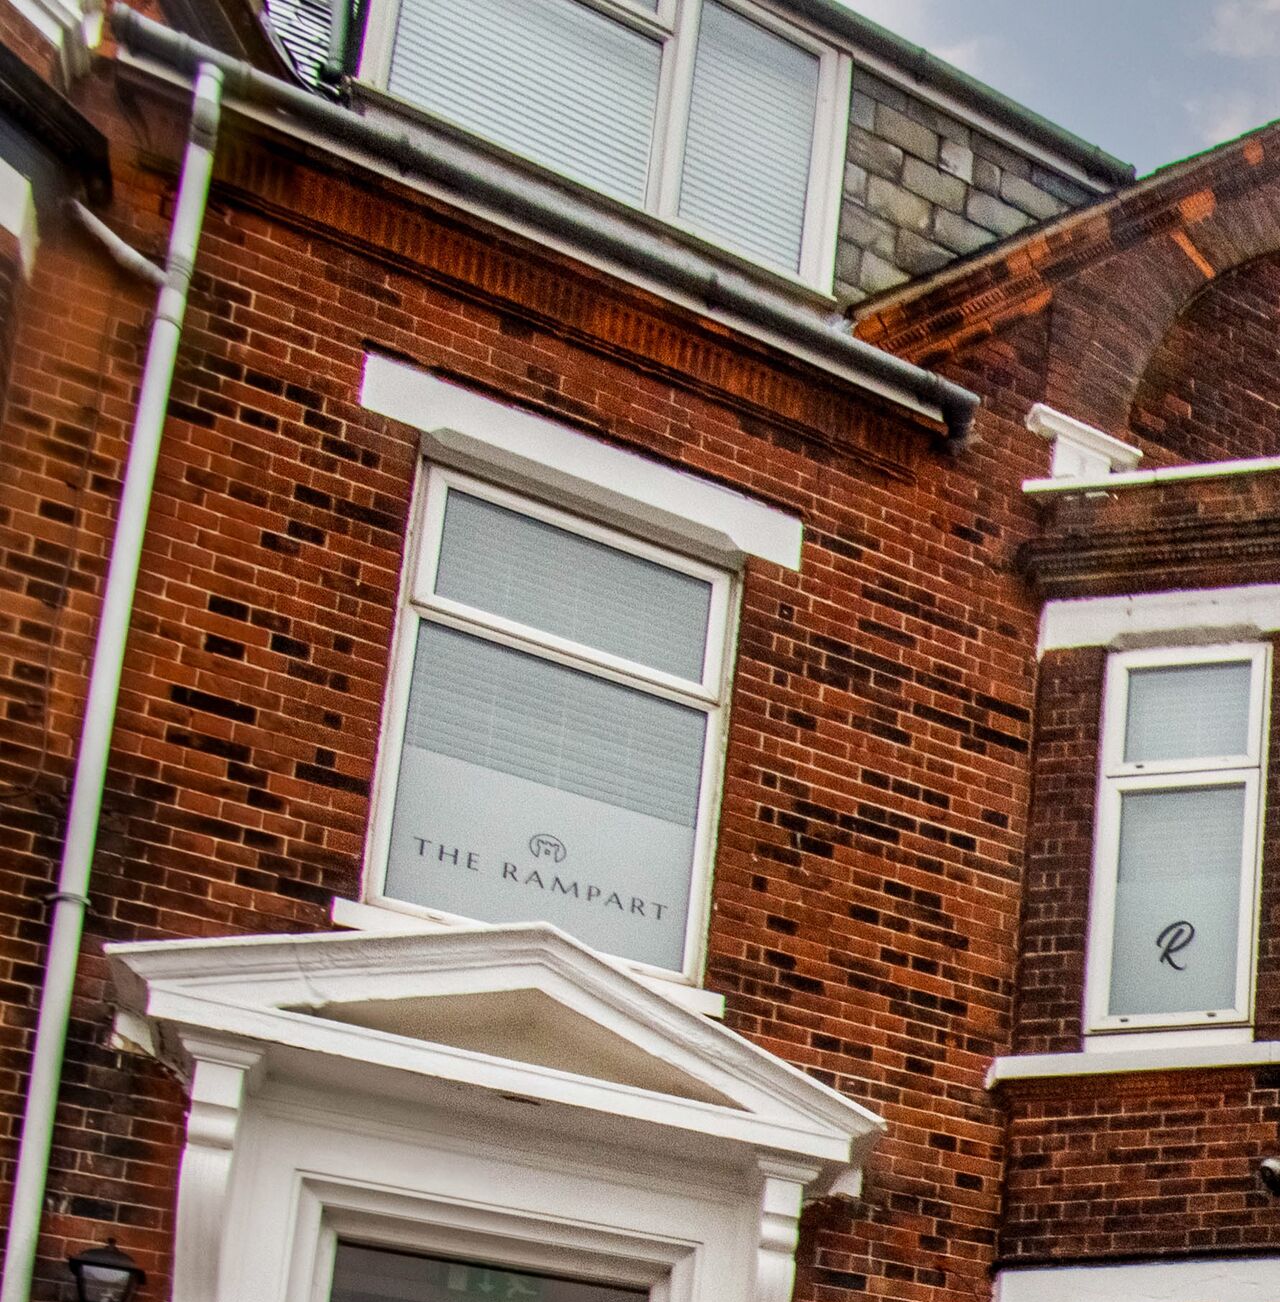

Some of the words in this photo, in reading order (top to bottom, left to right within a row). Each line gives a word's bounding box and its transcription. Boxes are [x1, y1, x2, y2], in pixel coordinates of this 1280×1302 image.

[413, 836, 480, 870] THE
[502, 861, 668, 921] RAMPART
[1156, 920, 1195, 971] R
